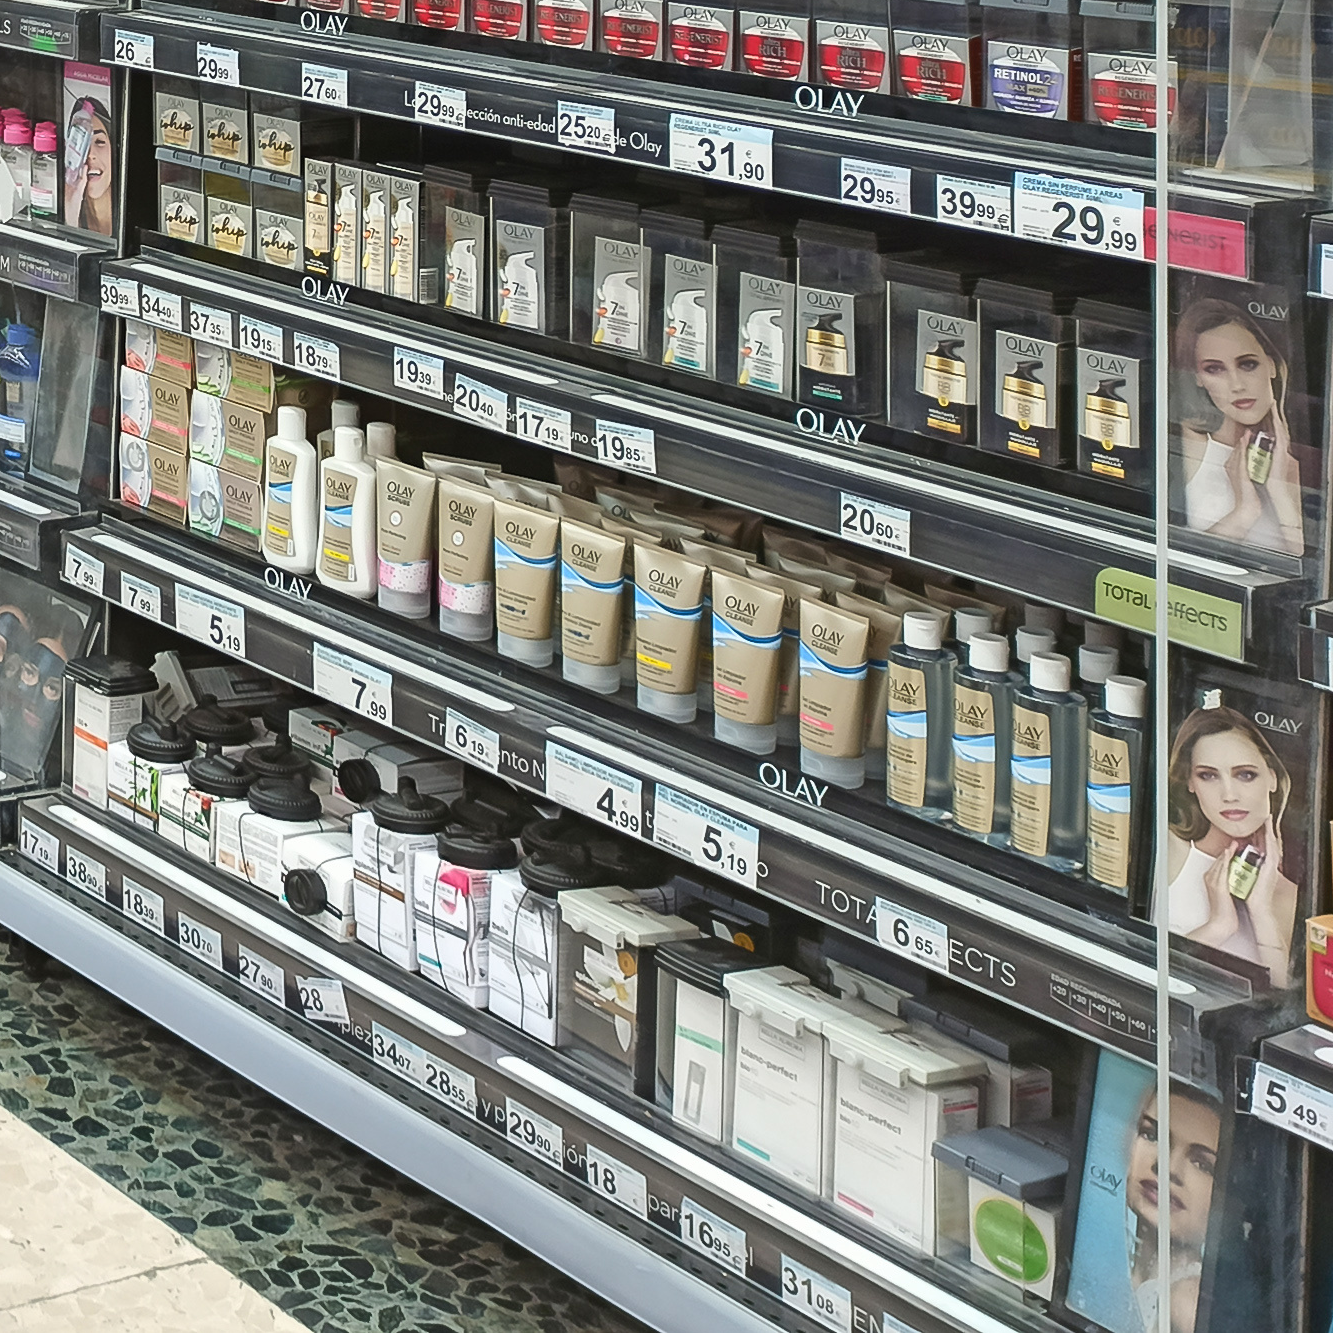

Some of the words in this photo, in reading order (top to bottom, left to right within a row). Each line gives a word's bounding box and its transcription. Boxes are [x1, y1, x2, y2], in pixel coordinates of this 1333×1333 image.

[300, 12, 348, 35] OLAY
[115, 37, 135, 61] 26
[794, 85, 865, 117] OLAY
[503, 111, 556, 135] anti-edad
[612, 131, 627, 144] de
[628, 131, 663, 157] Olay
[301, 276, 349, 305] OLAY
[1248, 300, 1289, 319] OLAY
[795, 407, 866, 446] OLAY
[387, 480, 415, 499] OLAY
[505, 520, 537, 541] OLAY
[505, 534, 530, 548] CLEANSE
[264, 568, 314, 602] OLAY
[759, 762, 829, 806] OLAY
